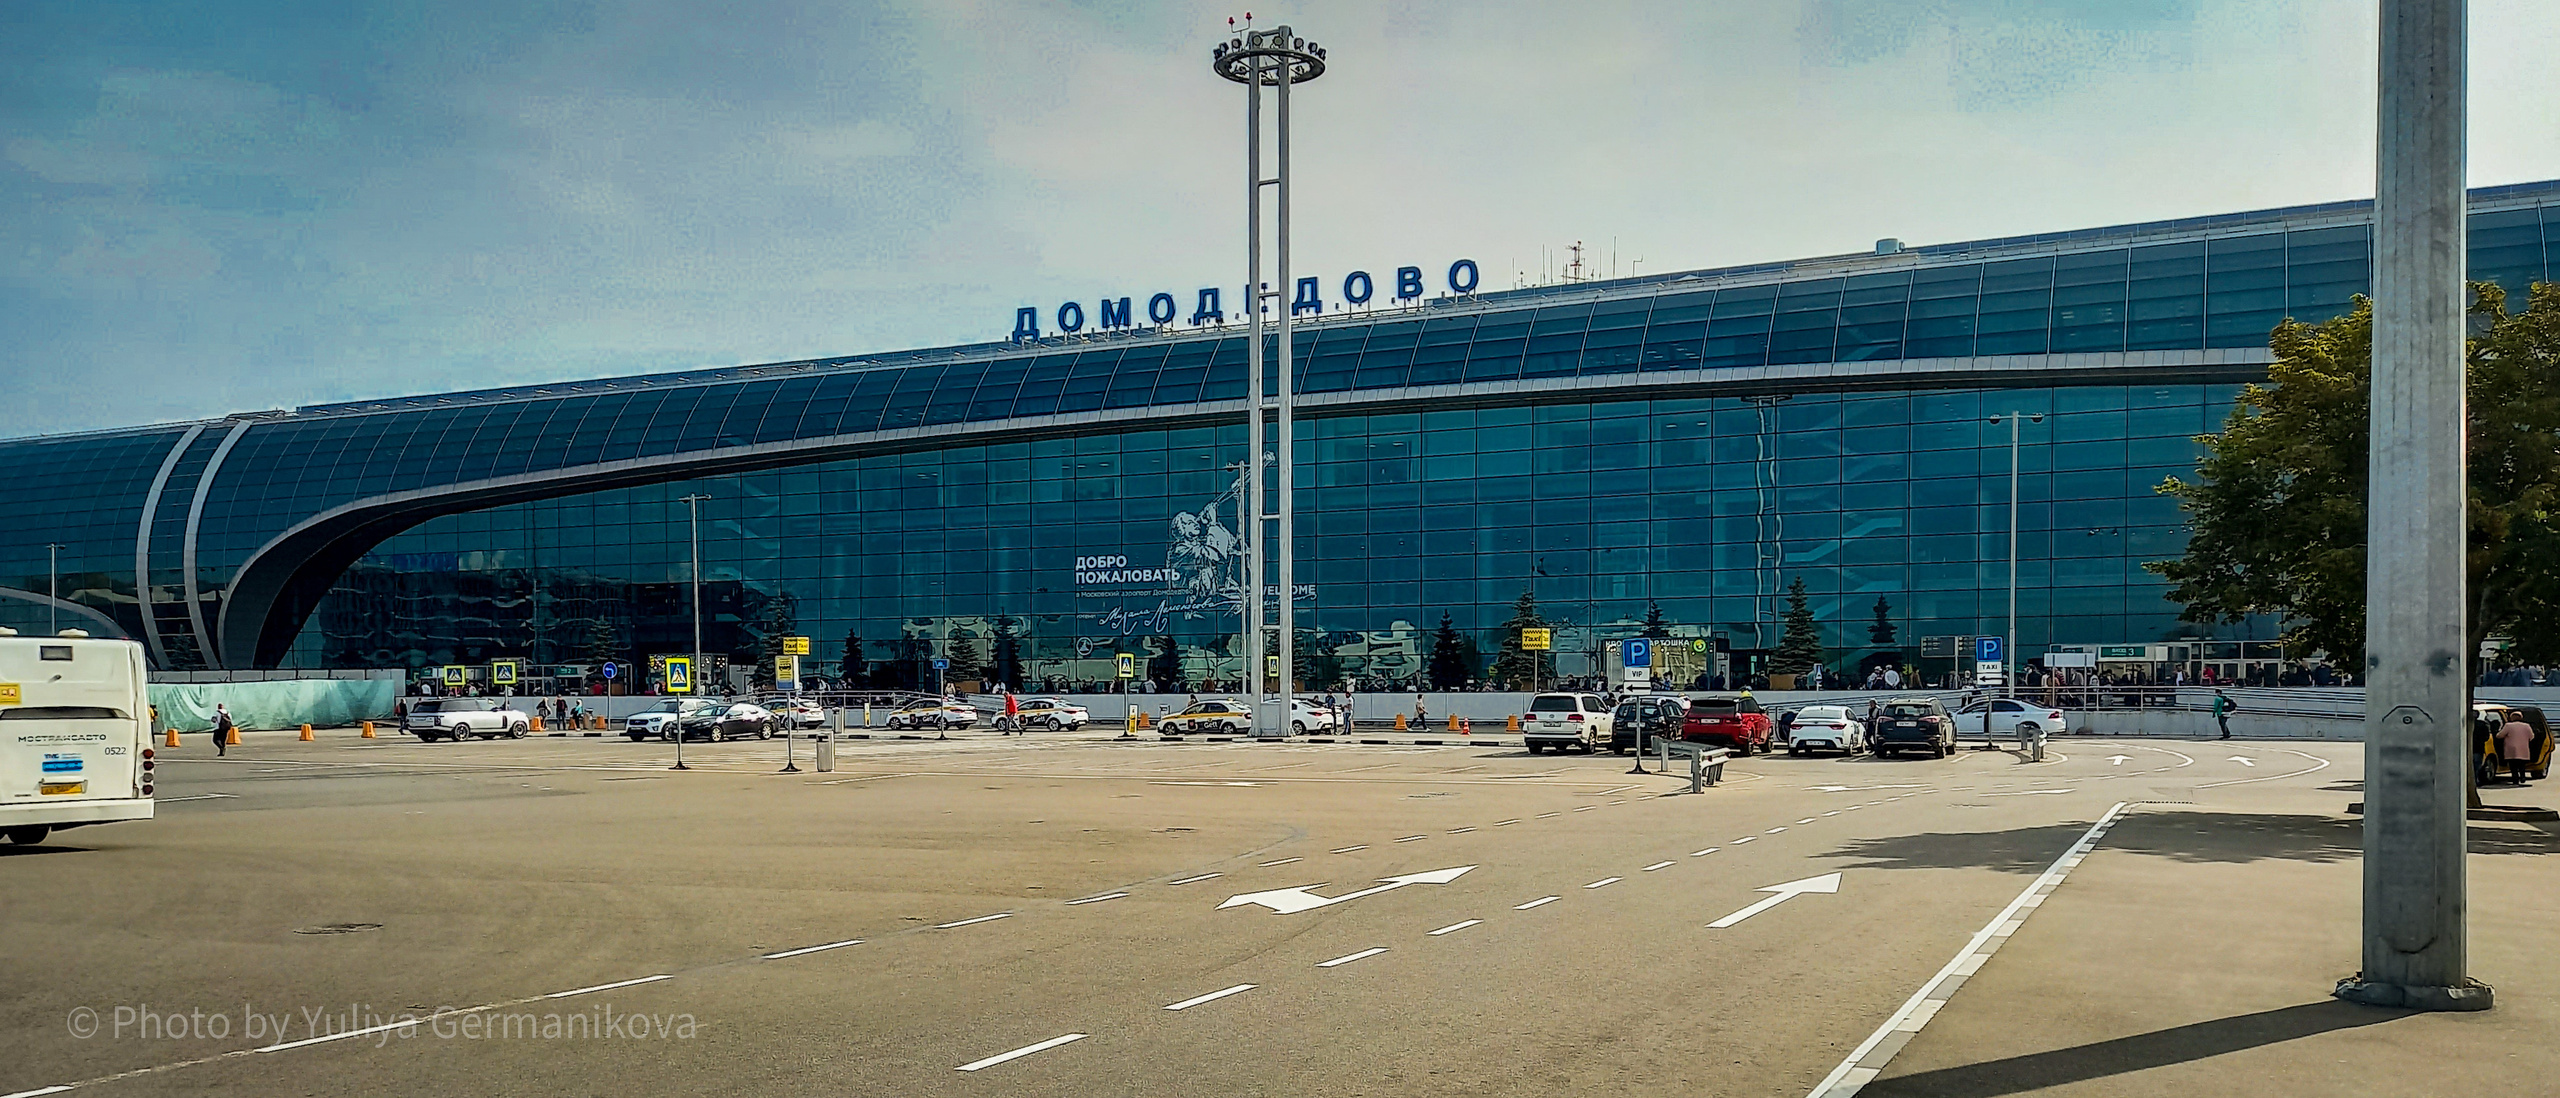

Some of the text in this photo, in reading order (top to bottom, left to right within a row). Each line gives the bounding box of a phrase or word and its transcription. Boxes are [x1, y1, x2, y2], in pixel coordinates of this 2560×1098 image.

[1075, 555, 1127, 571] ДОБРО
[1075, 568, 1181, 585] ПОЖАЛОВАТЬ
[1260, 585, 1316, 595] ELOME
[1650, 639, 1689, 647] АРТОШКА
[1983, 640, 1998, 659] P
[1630, 641, 1646, 664] P
[104, 747, 127, 756] 0522
